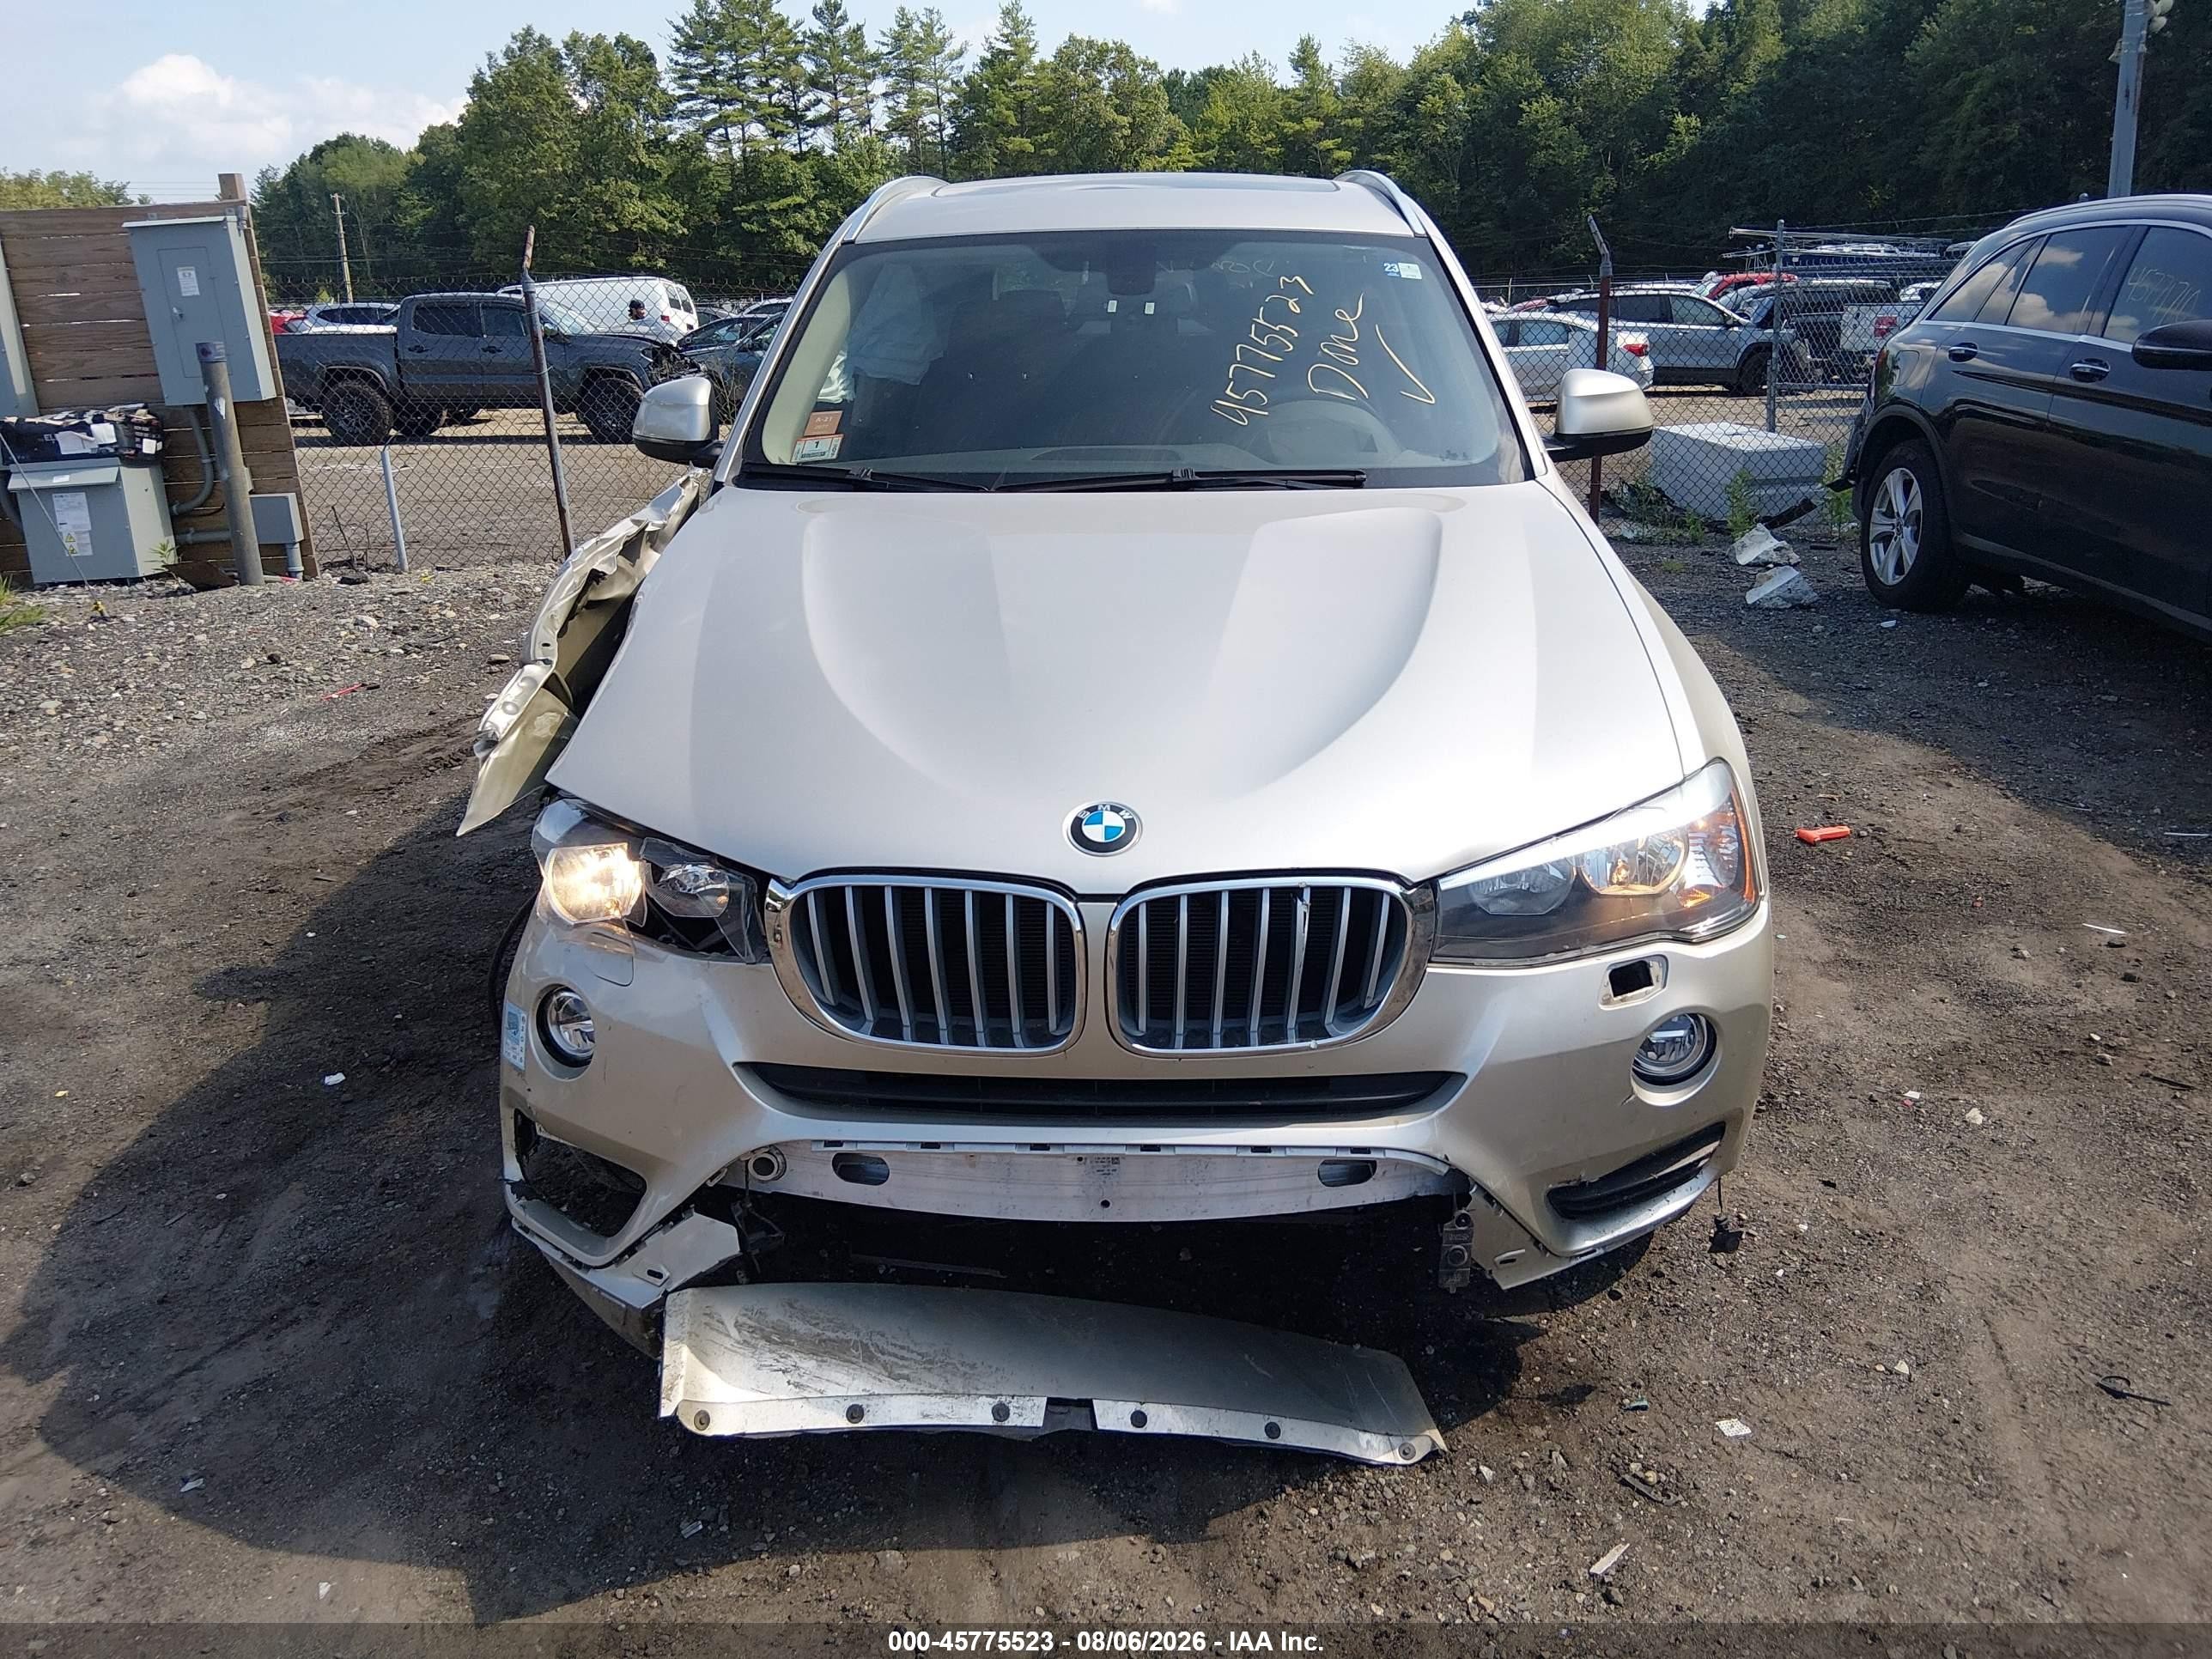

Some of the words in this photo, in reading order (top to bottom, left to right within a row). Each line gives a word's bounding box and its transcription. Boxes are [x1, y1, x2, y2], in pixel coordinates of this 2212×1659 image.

[1383, 263, 1400, 272] 23
[1211, 275, 1315, 426] 45775523
[1308, 291, 1369, 400] Done
[1077, 804, 1134, 819] BMW
